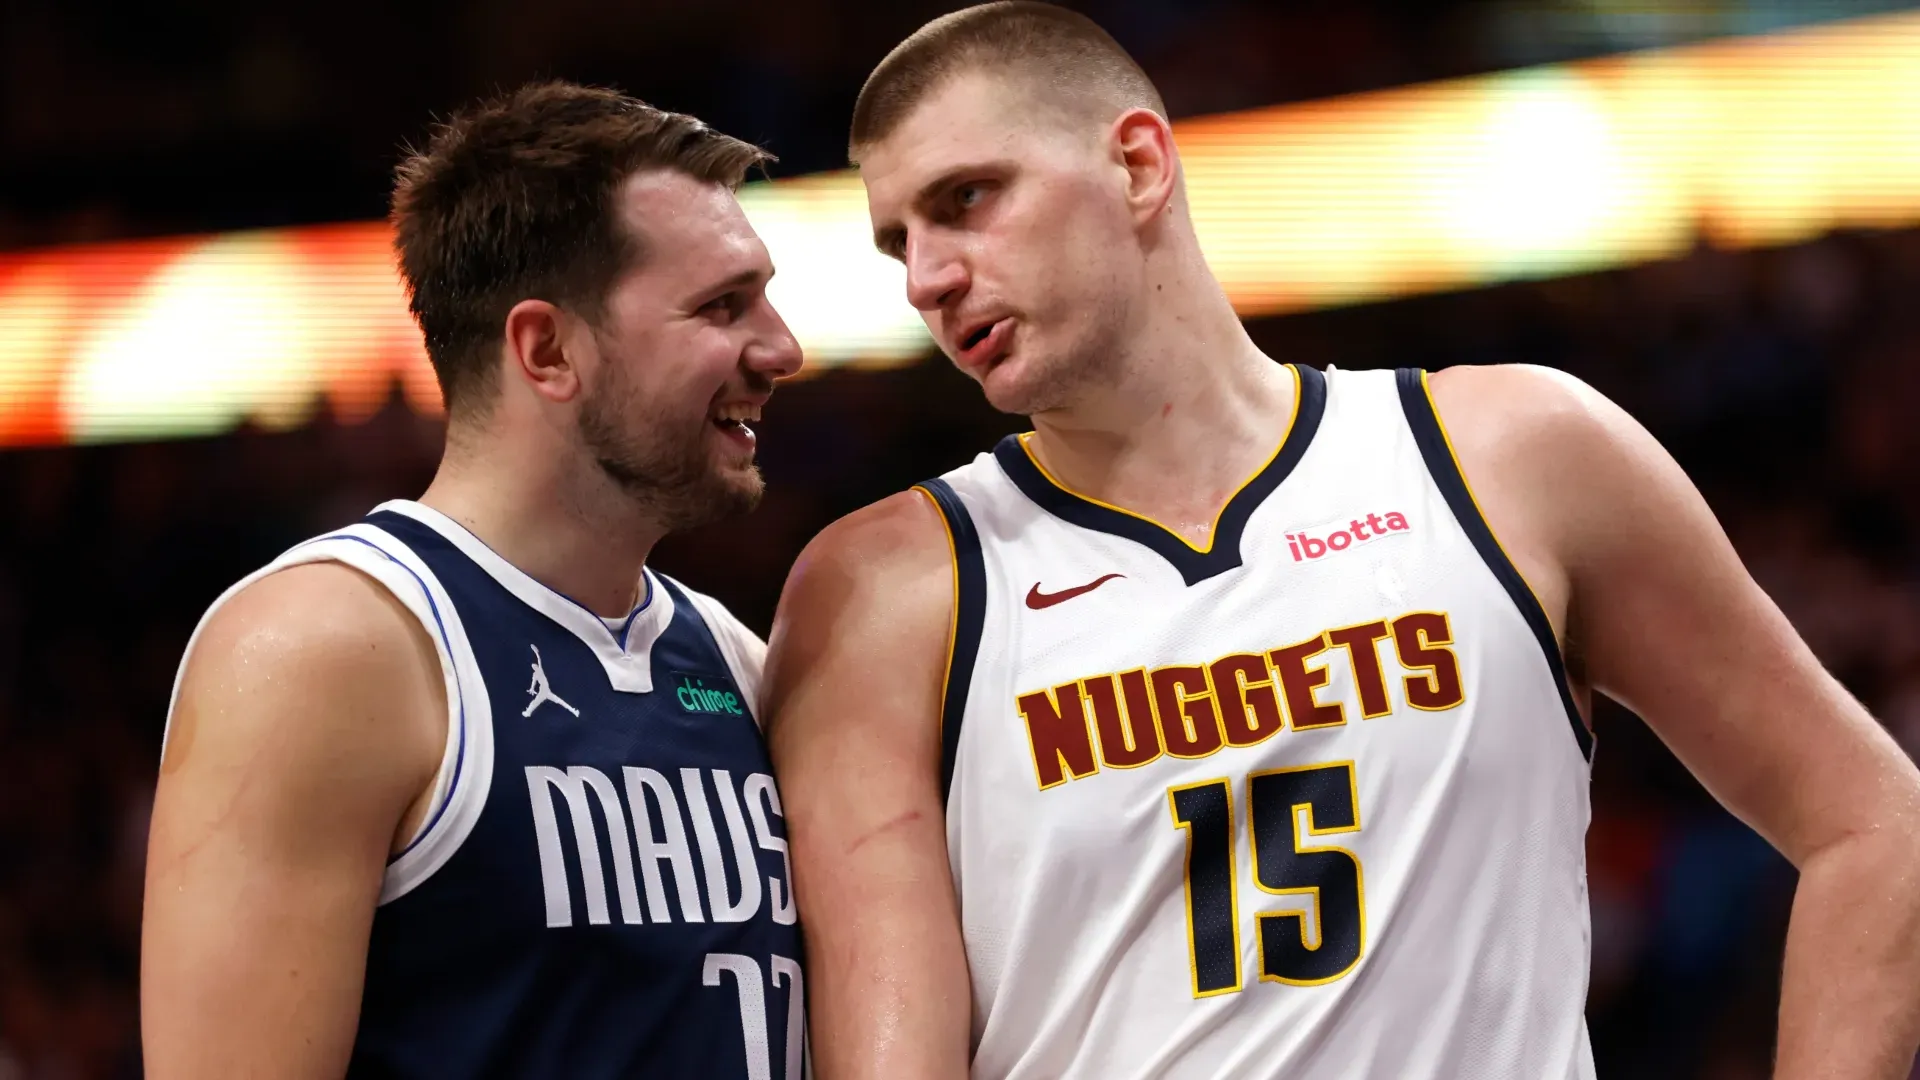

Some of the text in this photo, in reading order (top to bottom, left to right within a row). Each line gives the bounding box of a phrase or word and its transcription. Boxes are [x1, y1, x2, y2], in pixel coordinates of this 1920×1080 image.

[1285, 511, 1410, 562] ibotta
[677, 678, 743, 715] chime
[1015, 610, 1466, 791] NUGGETS
[1167, 760, 1367, 999] 15
